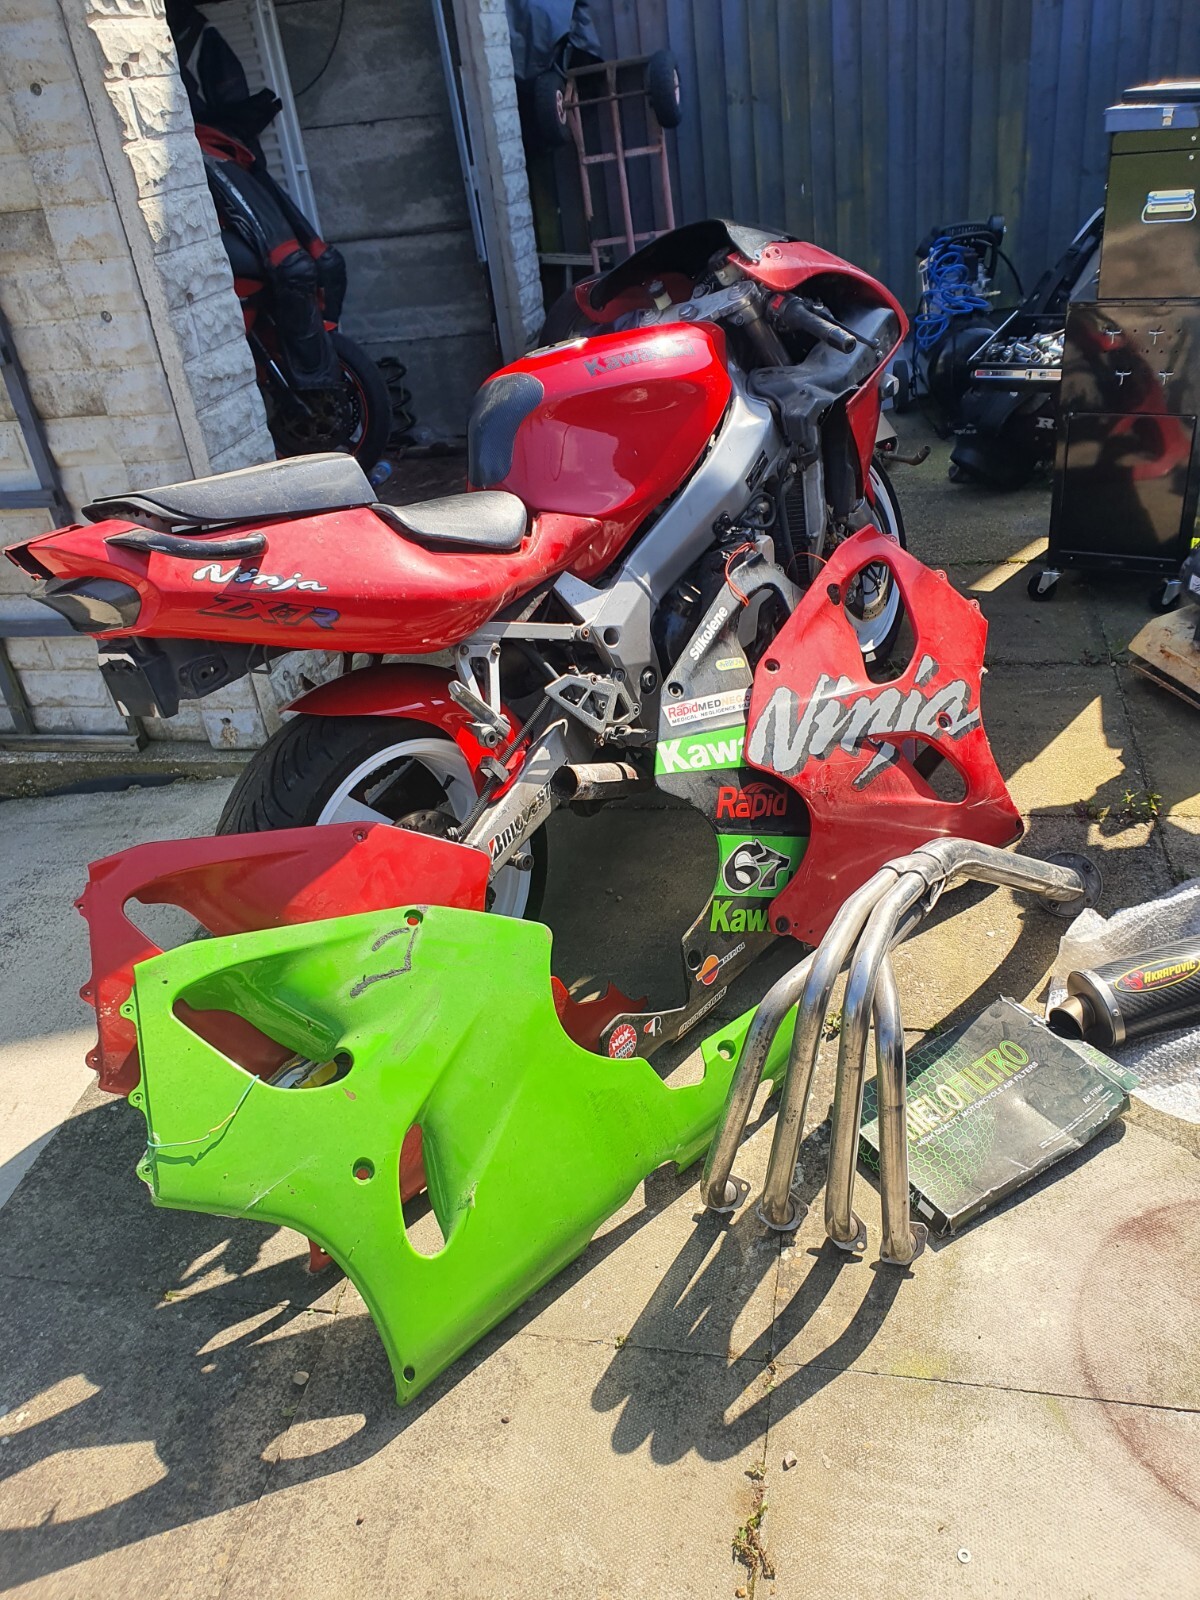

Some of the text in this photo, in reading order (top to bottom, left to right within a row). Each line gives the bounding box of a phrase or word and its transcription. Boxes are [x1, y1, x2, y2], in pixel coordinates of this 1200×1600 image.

[192, 563, 328, 592] Ninja
[689, 606, 728, 661] Silkolene
[671, 713, 698, 724] MEDICAL
[700, 705, 736, 717] NEGLIGENCE
[747, 654, 981, 791] Ninja
[716, 786, 787, 820] Rapid
[722, 839, 791, 893] 67
[709, 900, 772, 933] Kaw
[611, 1028, 631, 1050] NGK
[916, 1061, 1039, 1147] HIGH QUALITY MOTORCYCLE AIR FILTERS
[1082, 1083, 1105, 1105] Air Filter
